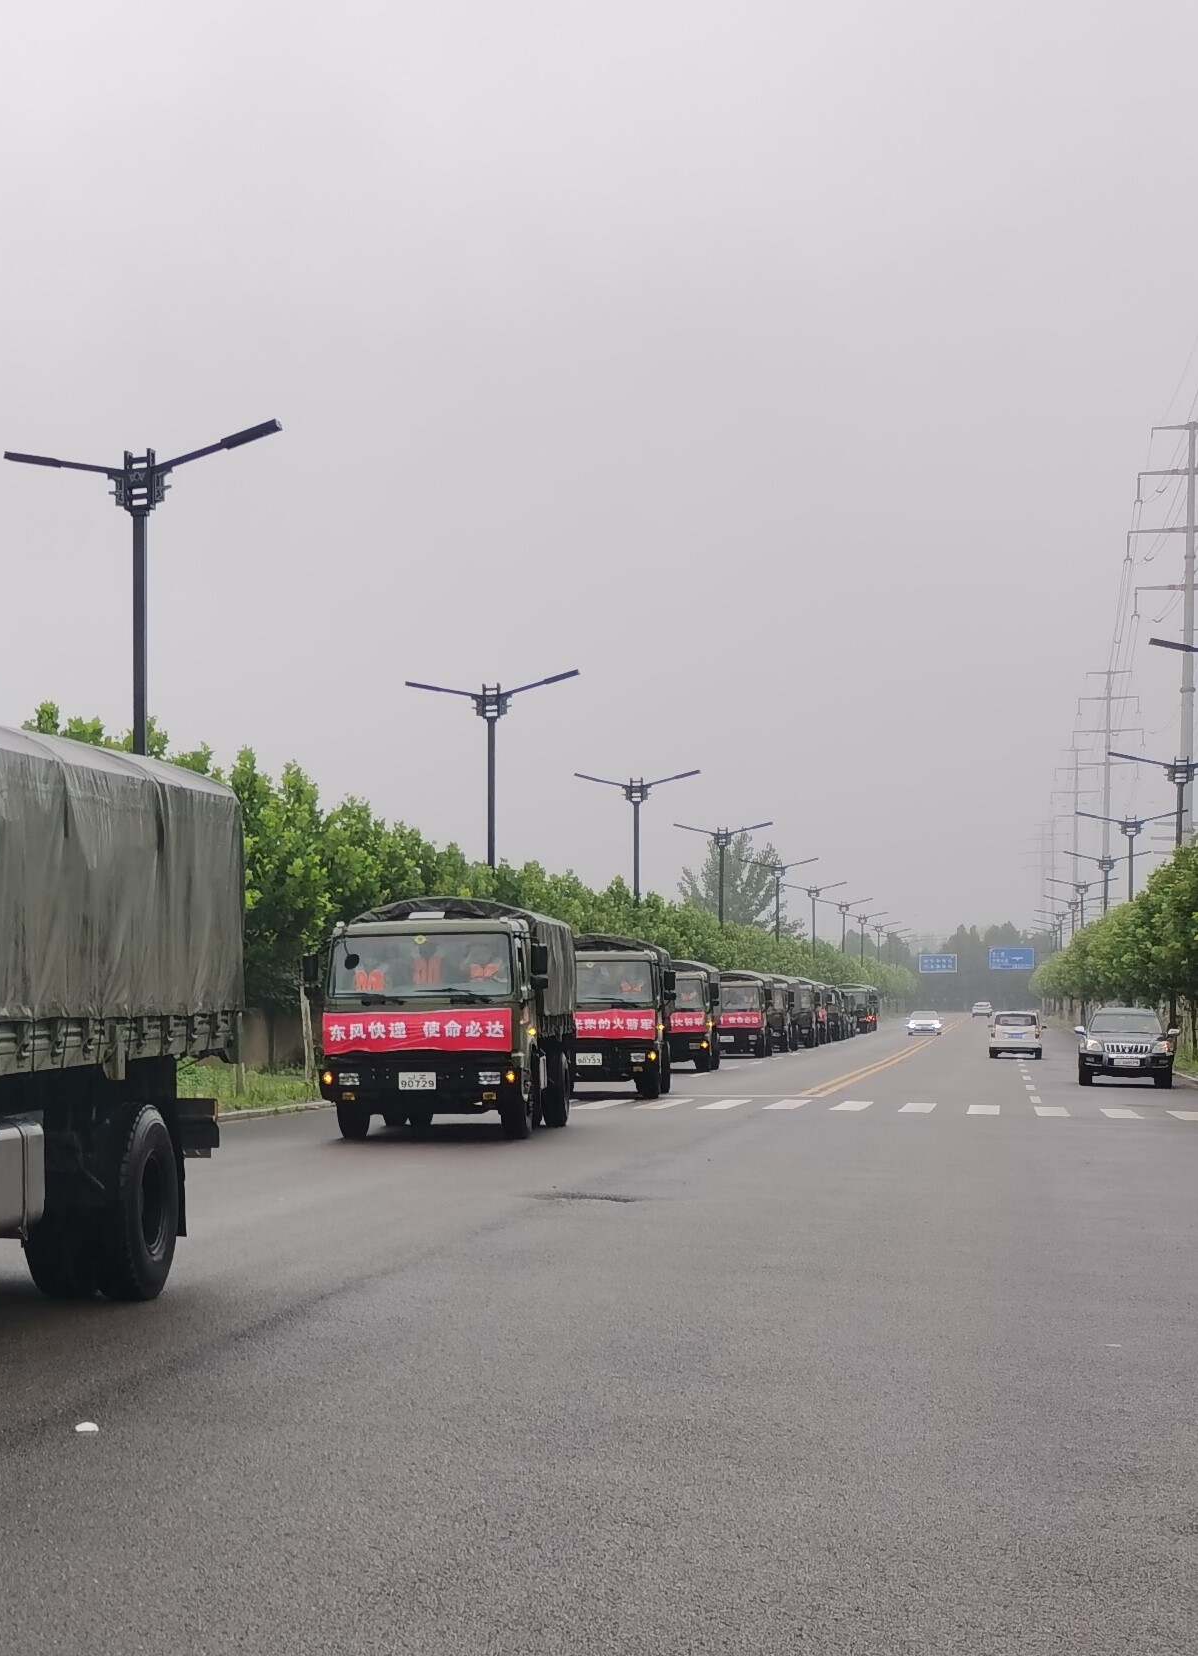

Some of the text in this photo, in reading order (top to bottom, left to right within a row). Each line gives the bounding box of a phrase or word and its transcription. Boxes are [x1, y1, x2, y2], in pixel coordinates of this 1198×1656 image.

[330, 1020, 505, 1041] 东风快递 使命必达
[400, 1080, 435, 1089] 90729
